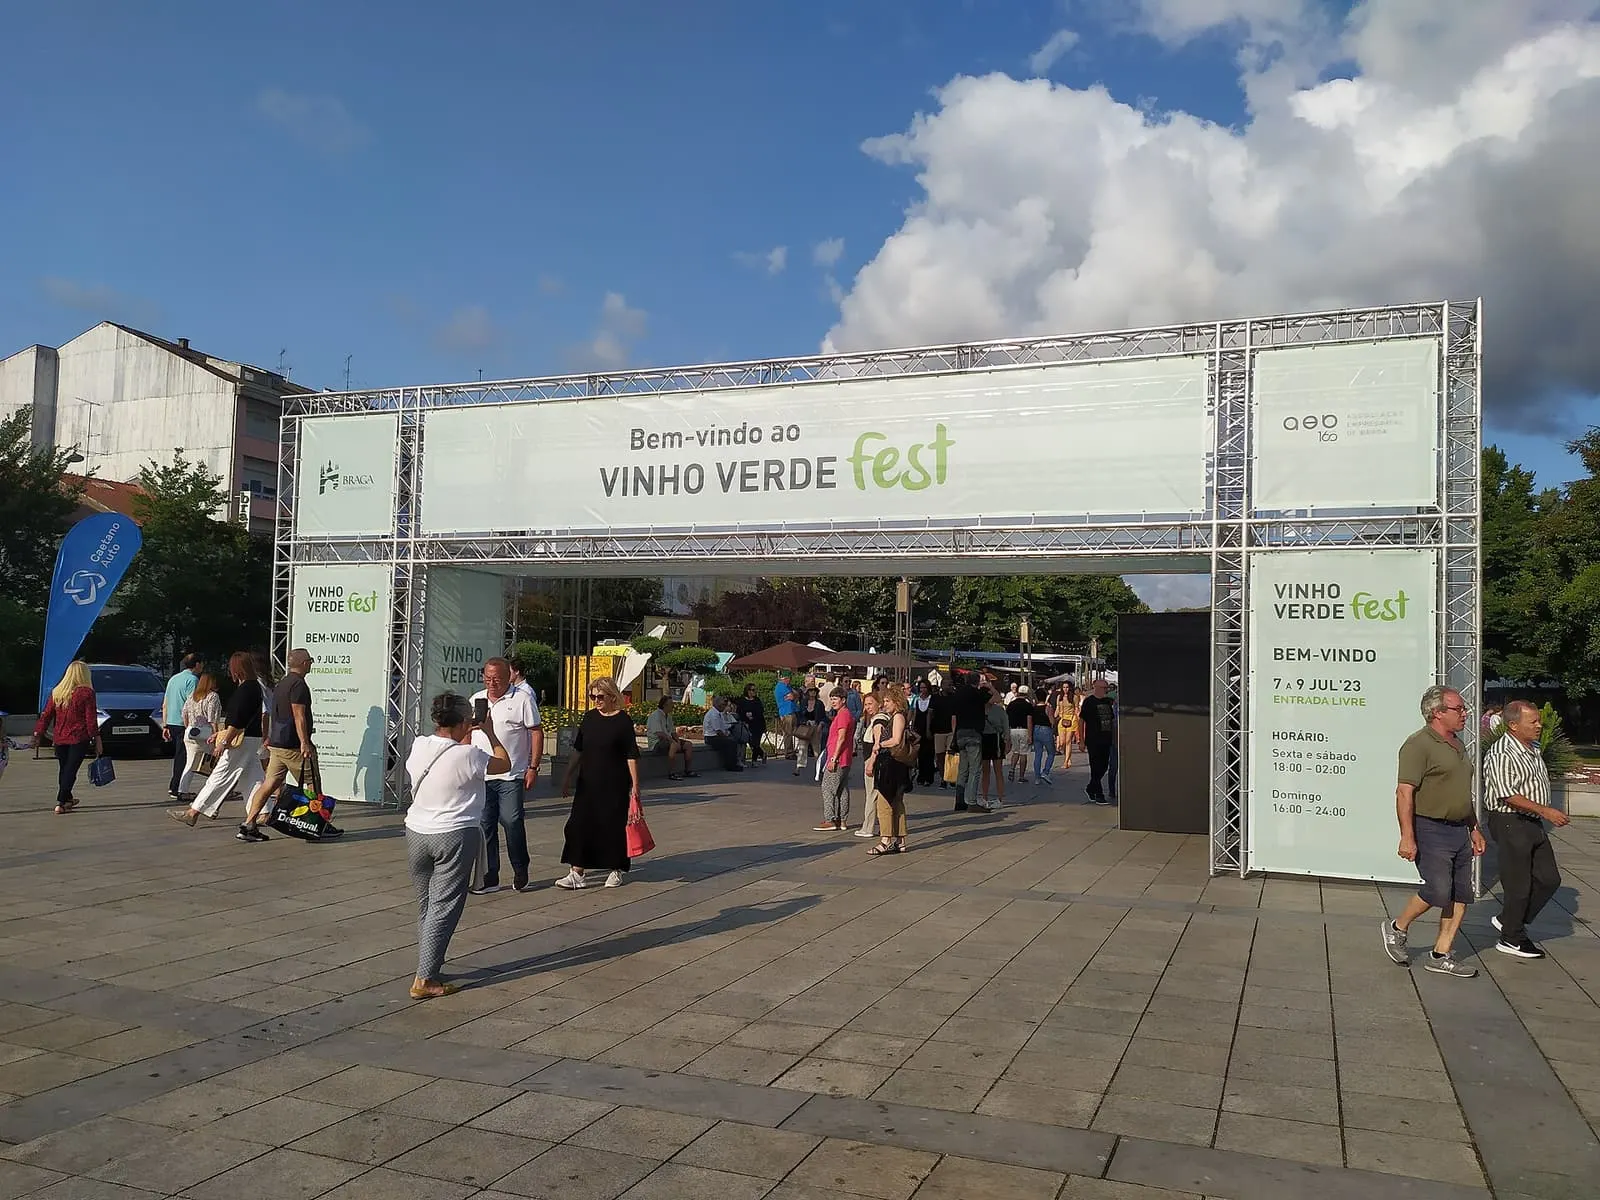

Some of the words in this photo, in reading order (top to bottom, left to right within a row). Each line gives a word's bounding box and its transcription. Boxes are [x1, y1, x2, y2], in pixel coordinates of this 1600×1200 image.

[630, 422, 762, 450] Bem-vindo
[771, 424, 801, 443] ao
[600, 463, 705, 497] VINHO
[716, 456, 837, 493] VERDE
[846, 423, 956, 491] fest
[342, 475, 374, 485] BRAGA
[90, 522, 120, 562] Caetano
[101, 544, 120, 568] Auto
[308, 586, 344, 597] VINHO
[1274, 583, 1341, 599] VINHO
[307, 600, 345, 612] VERDE
[347, 590, 378, 612] fest
[1274, 603, 1345, 619] VERDE
[1349, 590, 1410, 621] fest
[305, 633, 360, 643] BEM-VINDO
[317, 655, 322, 664] 9
[442, 645, 483, 663] VINHO
[1273, 648, 1377, 662] BEM-VINDO
[441, 667, 484, 683] VERDE
[1273, 678, 1282, 689] 7
[1296, 678, 1305, 690] 9
[1309, 679, 1361, 692] JUL'23
[1273, 695, 1329, 705] ENTRADA
[1332, 697, 1366, 707] LIVRE
[1272, 729, 1329, 742] HORÁRIO:
[1272, 748, 1303, 759] Sexta
[1316, 750, 1357, 761] sábado
[1273, 762, 1302, 772] 18:00
[1315, 764, 1346, 775] 02:00
[1272, 789, 1322, 803] Domingo
[1273, 803, 1302, 814] 16:00
[1315, 806, 1346, 817] 24:00
